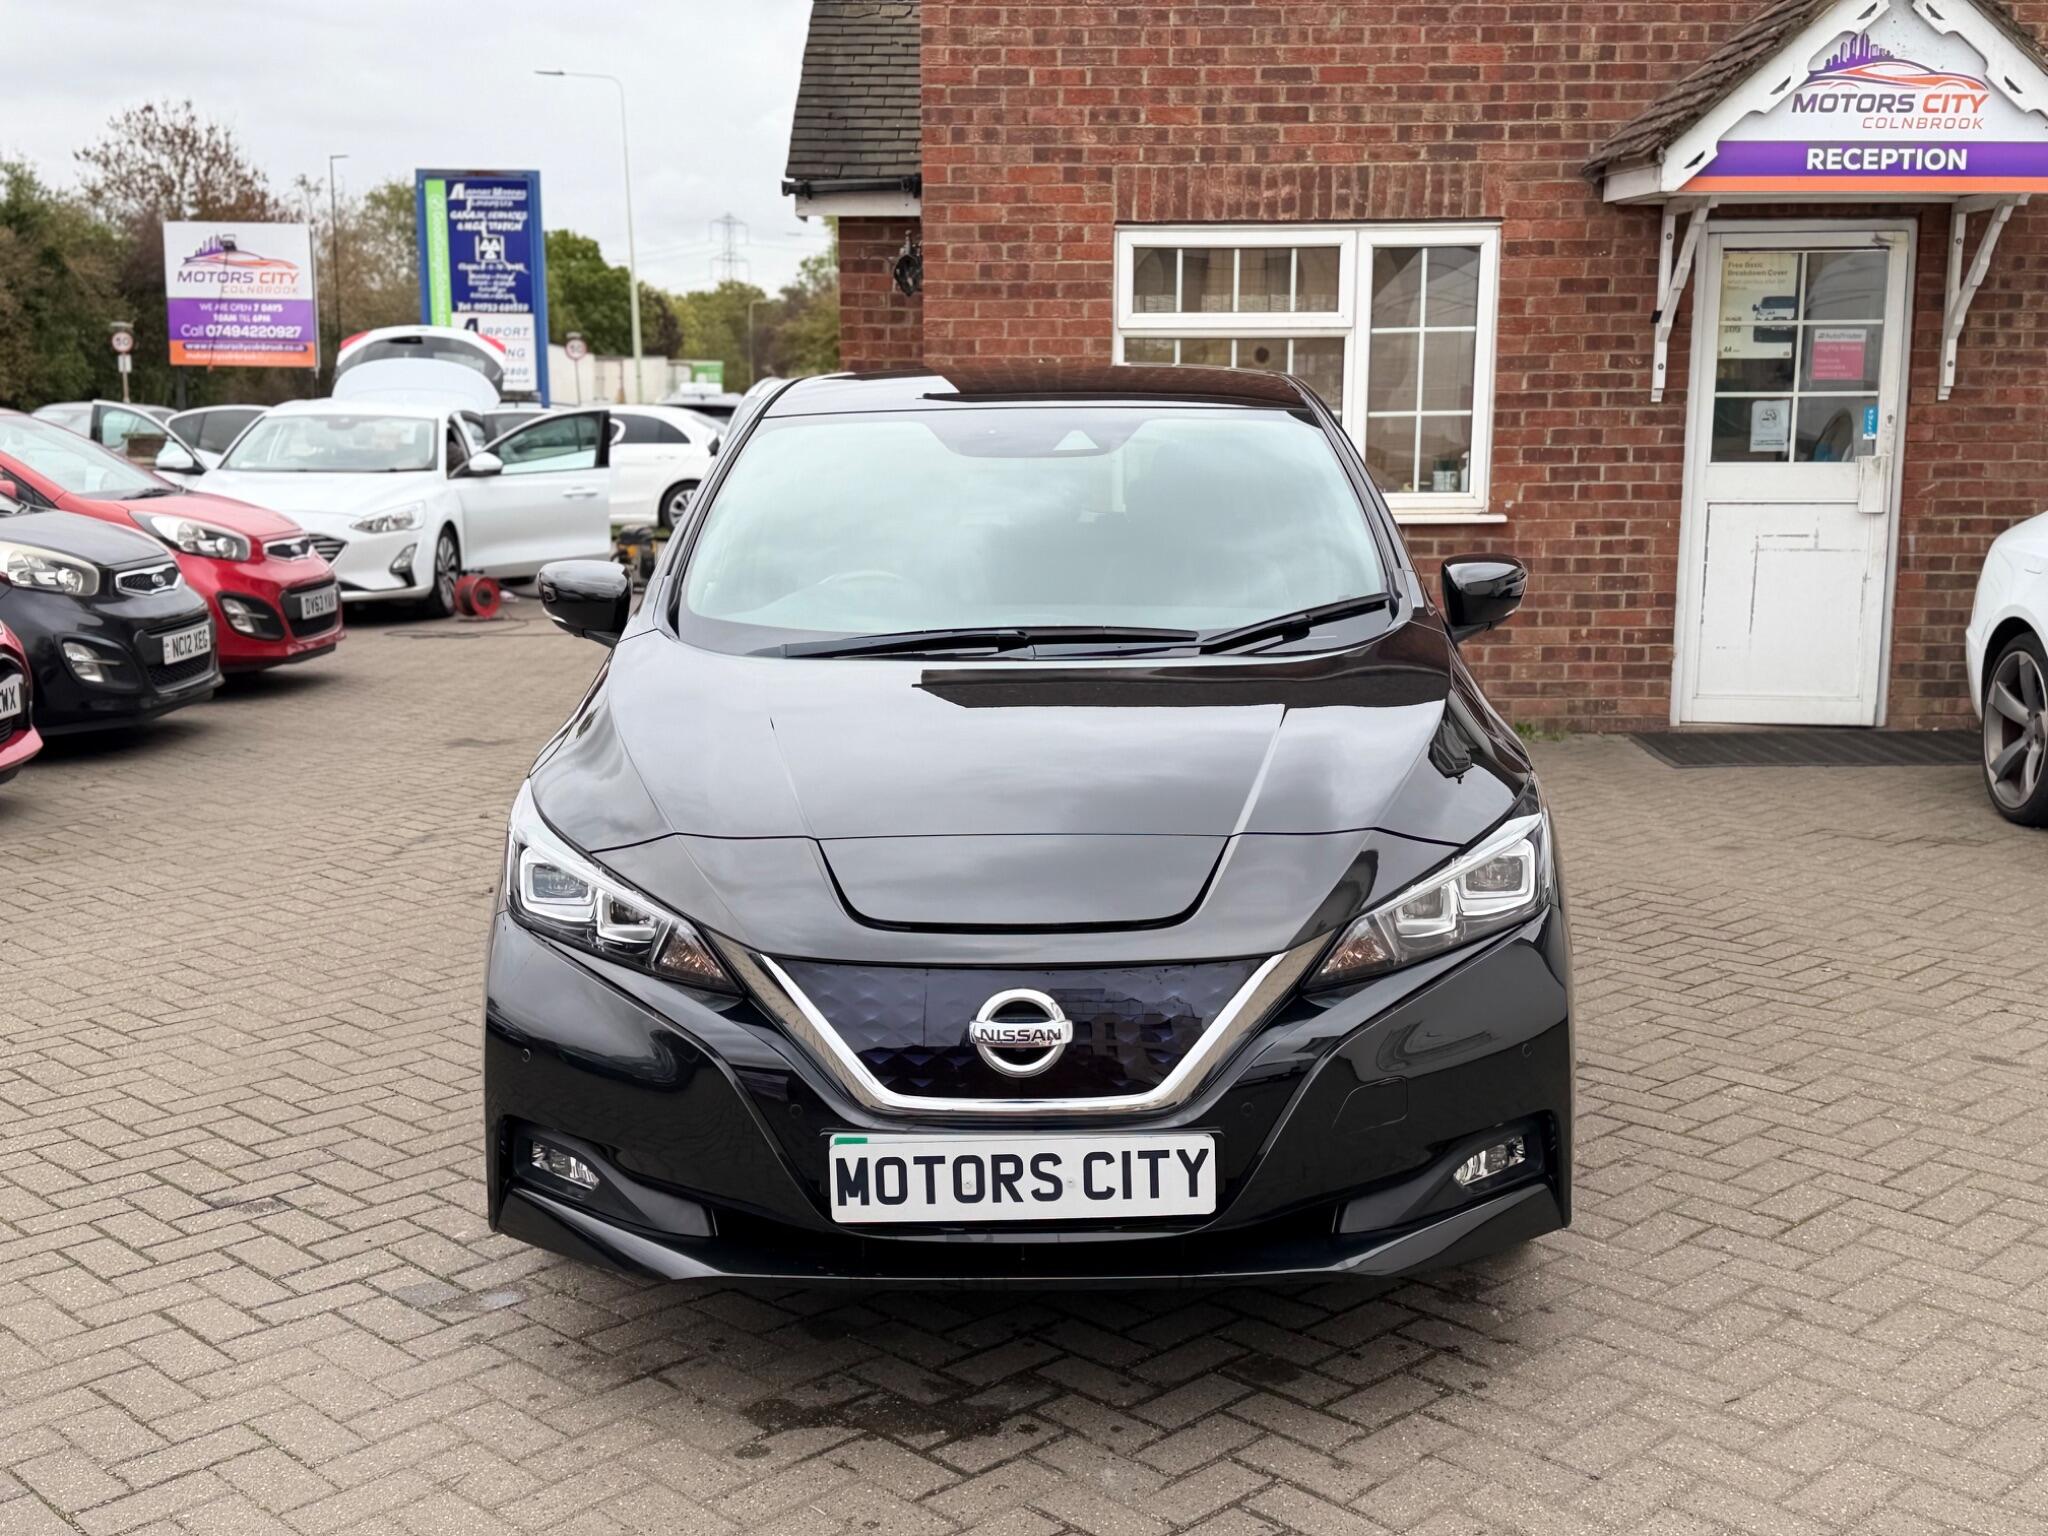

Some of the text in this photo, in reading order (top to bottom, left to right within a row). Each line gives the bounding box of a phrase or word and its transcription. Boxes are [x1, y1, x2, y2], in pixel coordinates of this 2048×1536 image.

[1791, 93, 1990, 114] MOTORS CITY
[1862, 117, 1984, 130] COLNBROOK
[1806, 147, 1968, 171] RECEPTION
[177, 271, 300, 284] MOTORS CITY
[222, 284, 299, 295] COLNBROOK
[180, 324, 205, 337] Call
[172, 634, 192, 658] NC12
[979, 1027, 1062, 1043] NISSAN
[836, 1148, 1210, 1206] MOTORS CITY
